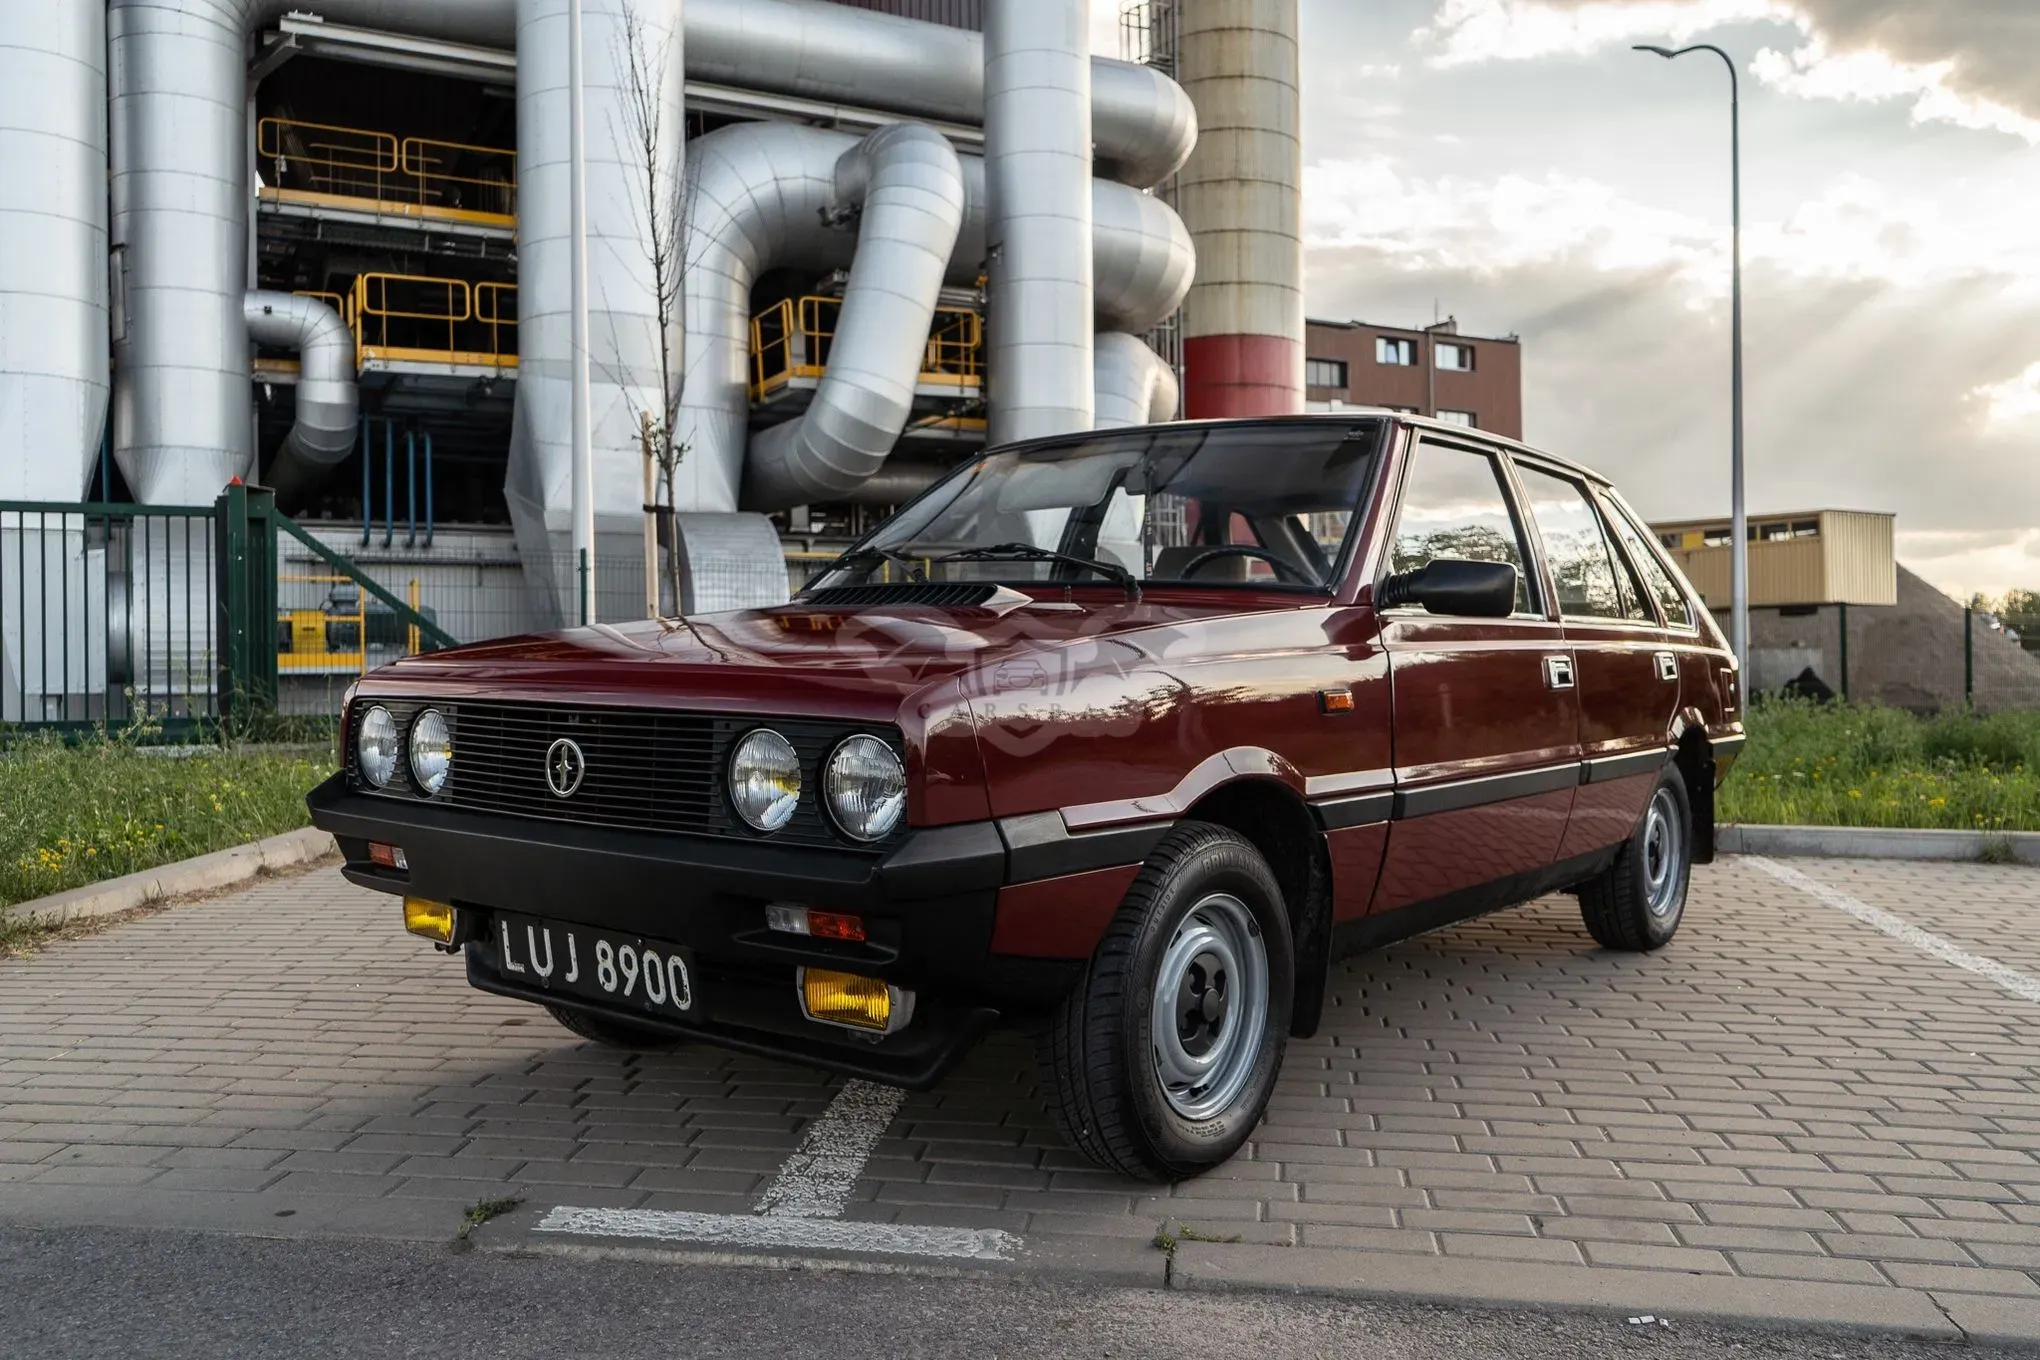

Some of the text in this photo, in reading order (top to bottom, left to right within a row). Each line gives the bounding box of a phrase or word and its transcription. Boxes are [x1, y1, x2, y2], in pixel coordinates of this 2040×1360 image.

[1150, 886, 1176, 933] OUTSIDE
[501, 920, 692, 1011] LUJ 8900
